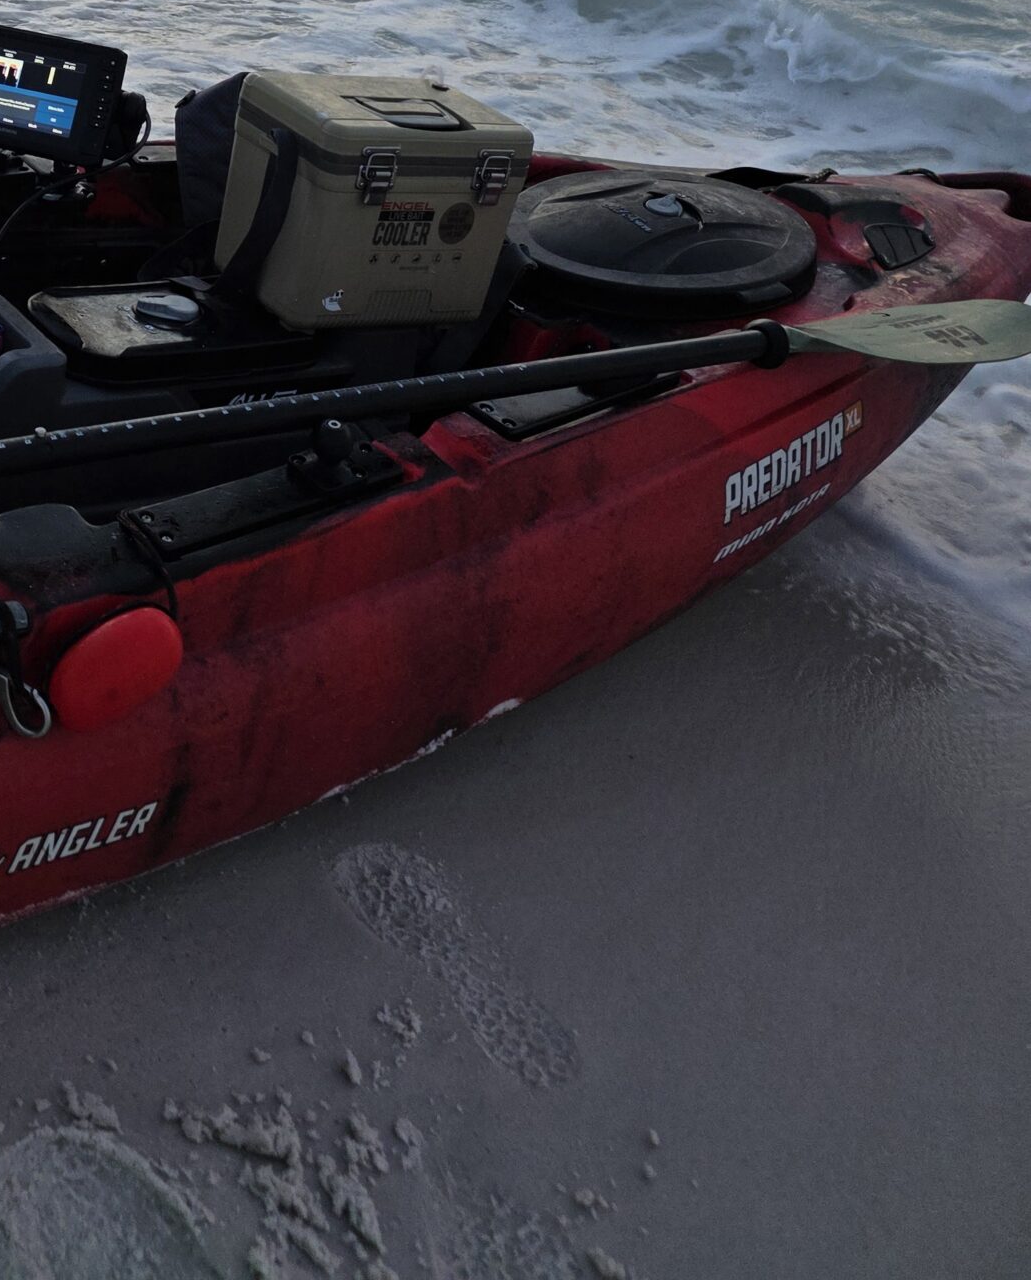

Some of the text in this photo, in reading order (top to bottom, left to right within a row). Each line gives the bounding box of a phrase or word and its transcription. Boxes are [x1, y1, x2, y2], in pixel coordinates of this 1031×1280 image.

[381, 201, 435, 211] ENGEL
[388, 211, 426, 221] LIVE BAIT
[372, 222, 432, 247] COOLER
[723, 407, 862, 526] PREDATOR XL
[7, 801, 159, 875] ANGLER
